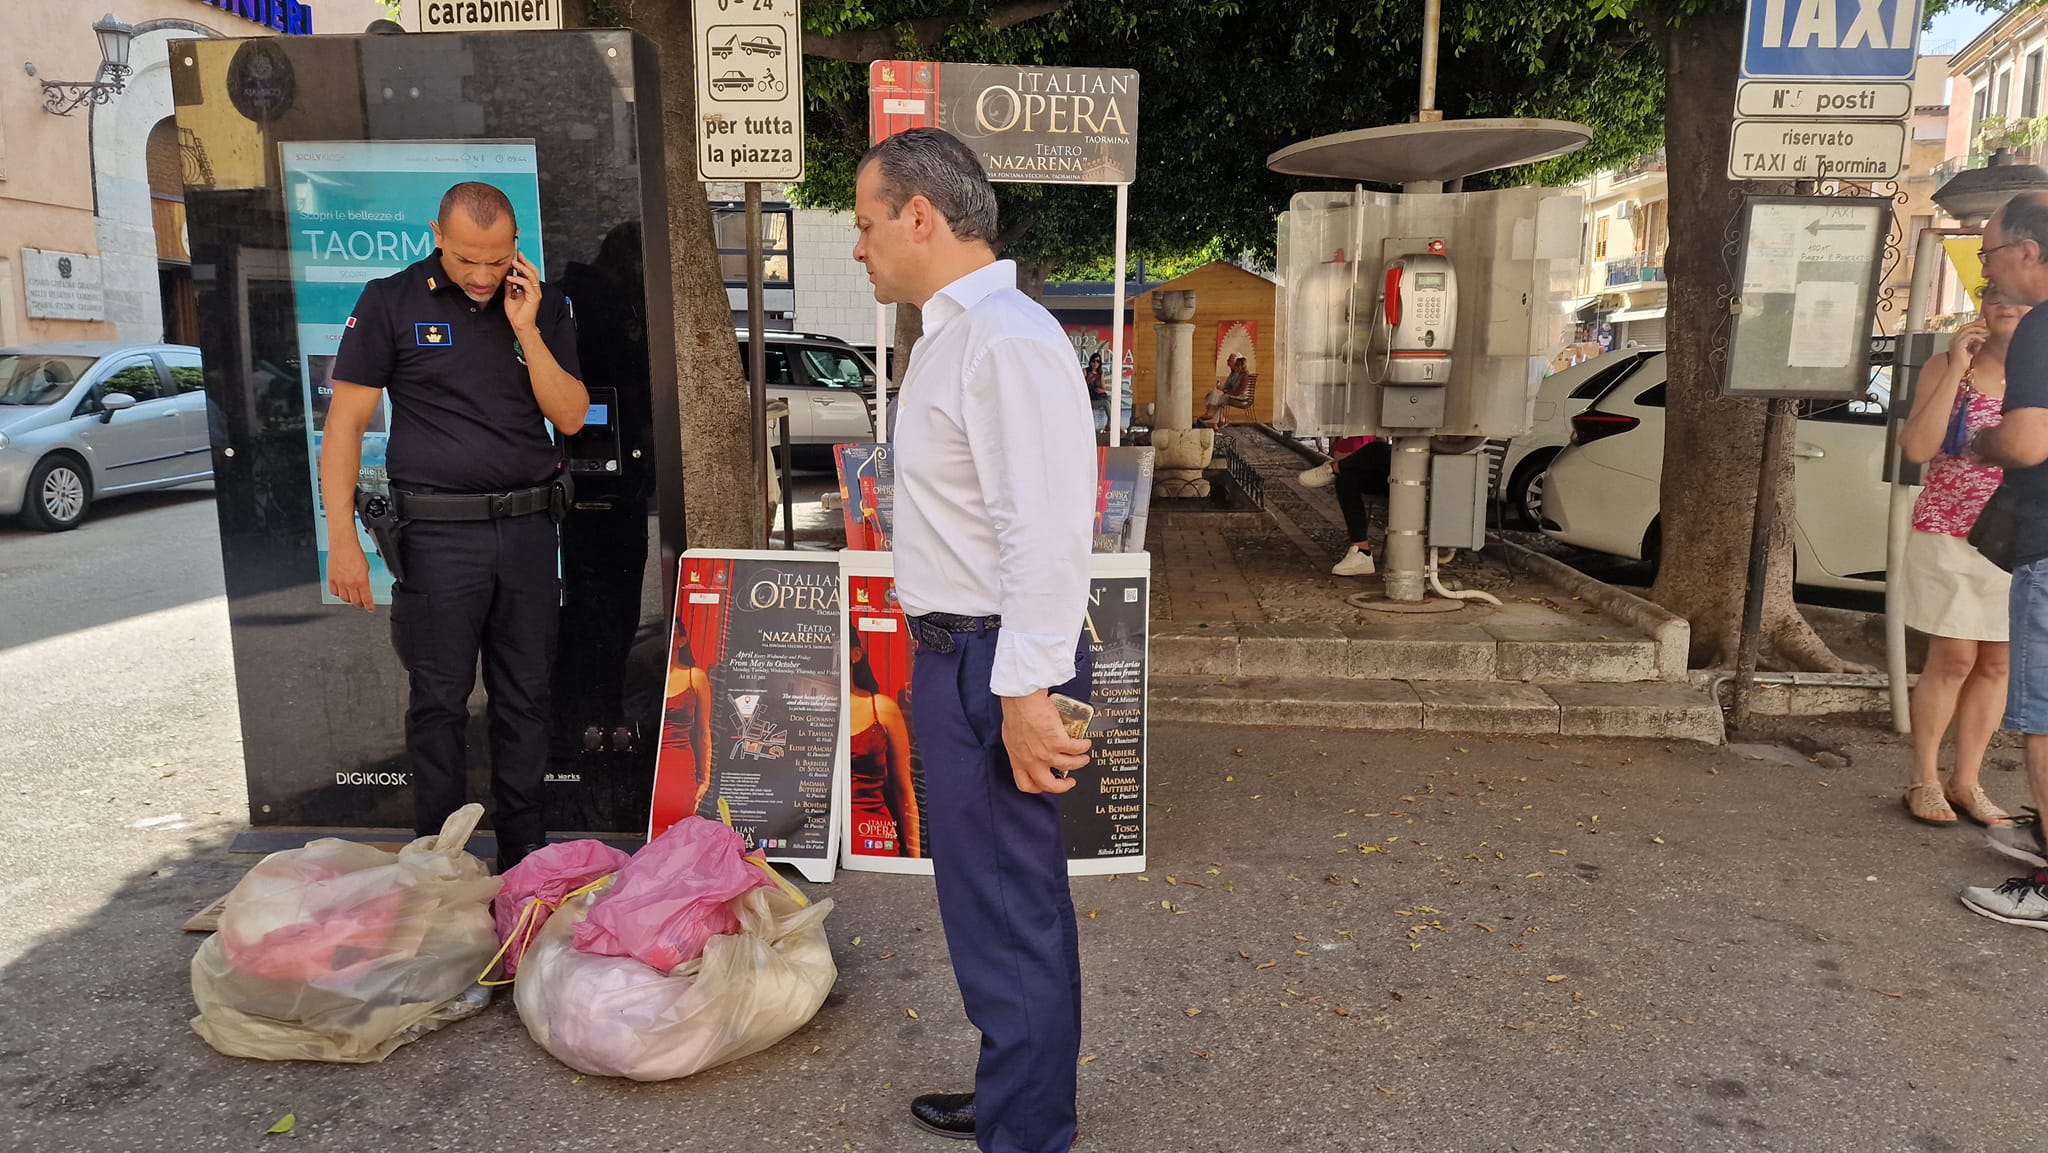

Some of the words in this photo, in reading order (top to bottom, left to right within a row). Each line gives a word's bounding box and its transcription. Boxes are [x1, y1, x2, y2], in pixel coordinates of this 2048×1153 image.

[429, 0, 549, 24] carabinieri
[1017, 72, 1129, 94] ITALIAN
[1816, 91, 1875, 112] posti
[976, 85, 1130, 135] OPERA
[706, 117, 737, 138] per
[745, 116, 792, 134] tutta
[1084, 135, 1130, 145] TAORMINA
[1782, 129, 1854, 146] riservato
[708, 144, 724, 162] la
[731, 144, 792, 167] piazza
[1744, 153, 1786, 171] TAXI
[1793, 156, 1806, 171] di
[1816, 155, 1887, 173] Taormina
[302, 208, 334, 223] Scopri
[336, 209, 346, 220] le
[348, 208, 392, 221] bellezze
[394, 209, 405, 220] di
[750, 580, 841, 611] OPERA
[735, 651, 754, 660] April
[729, 658, 748, 667] From
[749, 659, 765, 669] May
[774, 660, 801, 669] October
[1095, 661, 1124, 671] beautiful
[1101, 688, 1141, 697] GIOVANNI
[1105, 708, 1141, 717] TRAVIATA
[1092, 750, 1099, 758] IL
[1102, 749, 1136, 758] BARBIERE
[1109, 757, 1140, 766] SIVIGLIA
[336, 772, 408, 785] DIGIKIOSK
[557, 773, 581, 781] Works
[1101, 777, 1136, 785] MADAMA
[1100, 785, 1140, 793] BUTTERFLY
[1096, 805, 1105, 814] LA
[858, 822, 897, 835] OPERA
[1114, 824, 1139, 833] TOSCA
